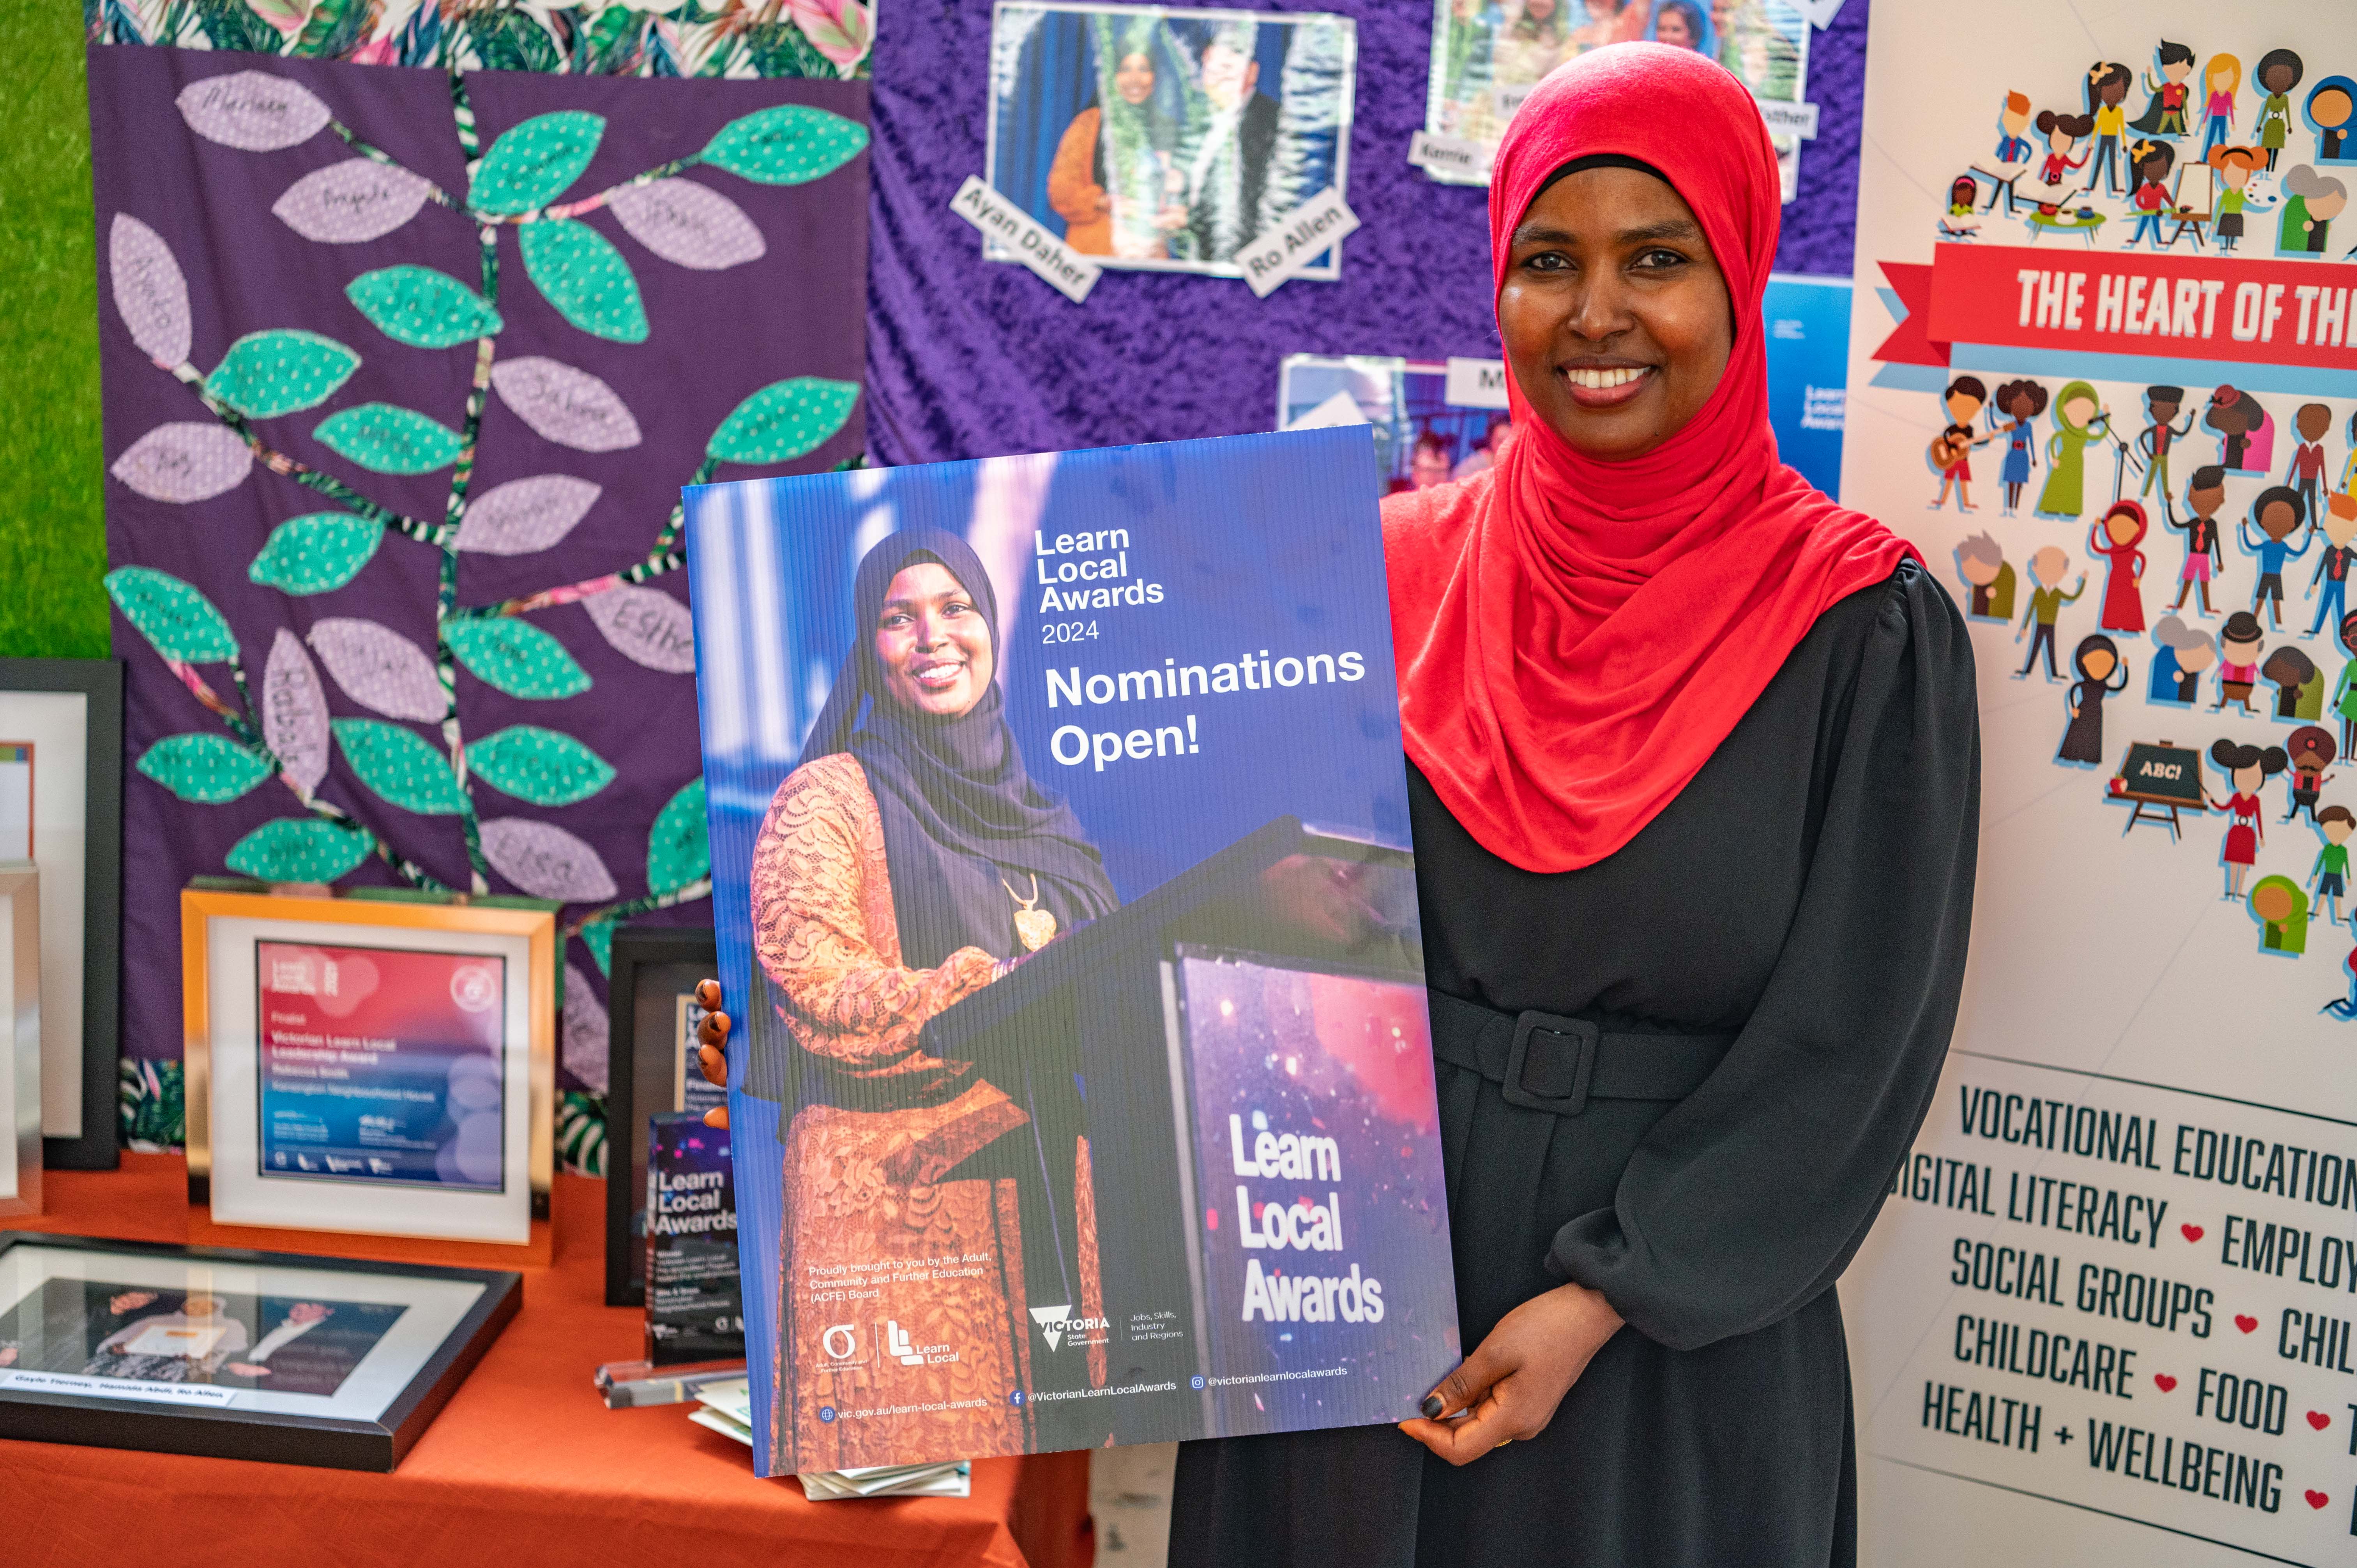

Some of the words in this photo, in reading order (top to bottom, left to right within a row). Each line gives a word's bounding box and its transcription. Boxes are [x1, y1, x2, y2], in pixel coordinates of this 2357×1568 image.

[962, 182, 1017, 237] Ayan
[1018, 226, 1089, 287] Daher
[1248, 253, 1283, 280] Ro
[1286, 203, 1341, 256] Allen
[2017, 269, 2087, 331] THE
[2094, 274, 2224, 339] HEART
[2232, 281, 2285, 343] OF
[1035, 528, 1129, 556] Learn
[1037, 551, 1127, 584] Local
[1039, 579, 1164, 613] Awards
[1042, 621, 1099, 644] 2024
[1046, 650, 1365, 708] Nominations
[1050, 715, 1199, 772] Open!
[2140, 761, 2182, 780] ABC!
[1960, 1085, 2160, 1171] VOCATIONAL
[1229, 1114, 1341, 1181] Learn
[659, 1171, 724, 1191] Learn
[659, 1188, 720, 1213] Local
[2008, 1171, 2168, 1249] LITERACY
[1236, 1185, 1343, 1251] Local
[809, 1265, 847, 1276] Proudly
[850, 1260, 890, 1273] brought
[893, 1260, 903, 1269] to
[906, 1259, 925, 1269] you
[927, 1257, 940, 1267] by
[943, 1255, 959, 1264] the
[962, 1252, 992, 1263] Adult,
[809, 1277, 868, 1290] Community
[871, 1273, 889, 1284] and
[893, 1271, 929, 1282] Further
[932, 1266, 983, 1279] Education
[1242, 1258, 1383, 1323] Awards
[1952, 1238, 2064, 1307] SOCIAL
[2077, 1263, 2214, 1339] GROUPS
[811, 1291, 845, 1304] (ACFE)
[848, 1289, 879, 1300] Board
[1037, 1317, 1110, 1333] VICTORIA
[1131, 1323, 1165, 1332] Industry
[1154, 1311, 1176, 1319] Skills,
[1067, 1338, 1109, 1346] Government
[1132, 1333, 1148, 1341] and
[1150, 1330, 1183, 1340] Regions
[916, 1344, 949, 1354] Learn
[927, 1352, 959, 1364] Local
[1208, 1366, 1347, 1387] @victorianlearnlocalawards
[1954, 1314, 2137, 1400] CHILDCARE
[2196, 1367, 2288, 1436] FOOD
[1028, 1381, 1176, 1403] @VictorianLearnLocalAwards
[838, 1398, 987, 1420] vic.gov.au/learn-local-awards
[1921, 1381, 2042, 1453] HEALTH
[2054, 1425, 2074, 1444] +
[2088, 1418, 2284, 1513] WELLBEING
